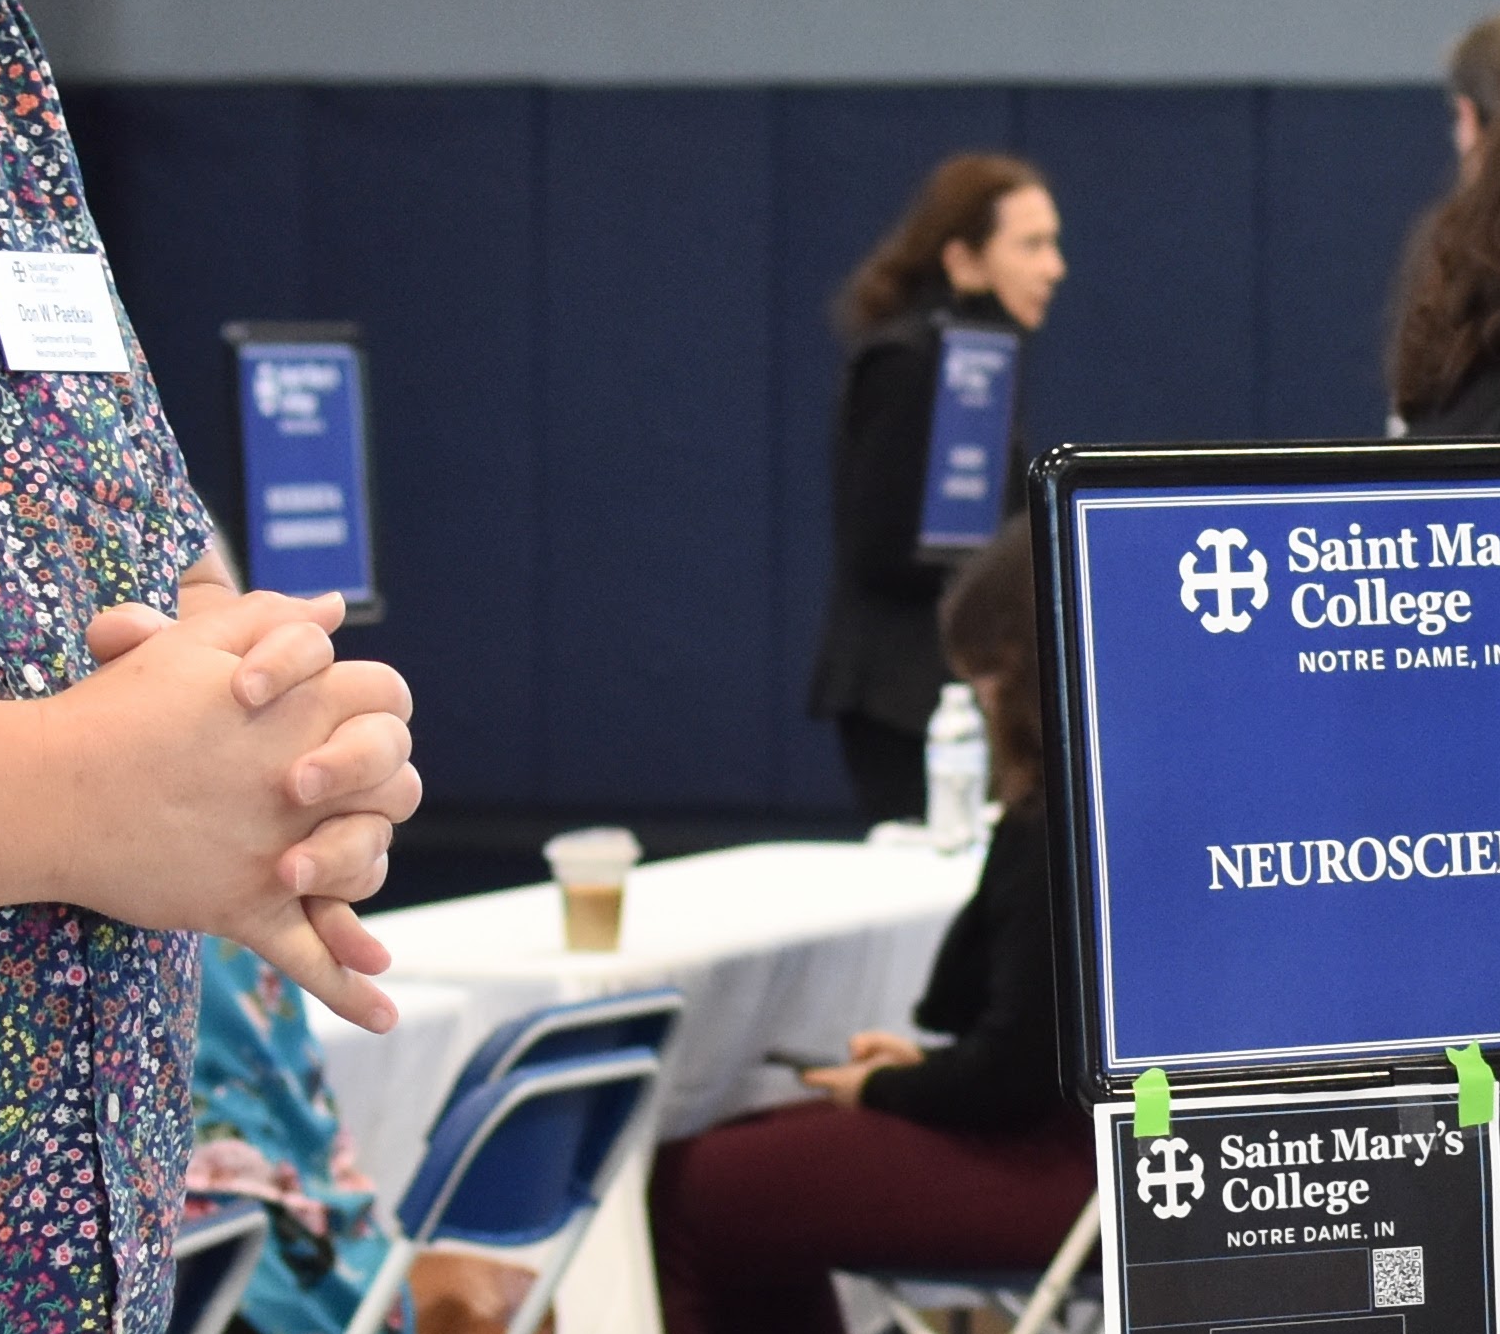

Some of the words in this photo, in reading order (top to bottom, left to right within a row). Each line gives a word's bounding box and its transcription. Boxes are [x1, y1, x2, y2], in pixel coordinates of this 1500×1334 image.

[18, 303, 40, 322] Don
[54, 303, 93, 323] Paetkau
[1289, 523, 1419, 572] Saint
[1291, 578, 1471, 635] College
[1299, 649, 1385, 673] NOTRE
[1396, 646, 1476, 670] DAME,
[1221, 1129, 1324, 1169] Saint
[1331, 1120, 1465, 1166] Mary's
[1222, 1172, 1370, 1215] College
[1227, 1227, 1296, 1248] NOTRE
[1304, 1222, 1368, 1244] DAME,
[1373, 1220, 1395, 1239] IN
